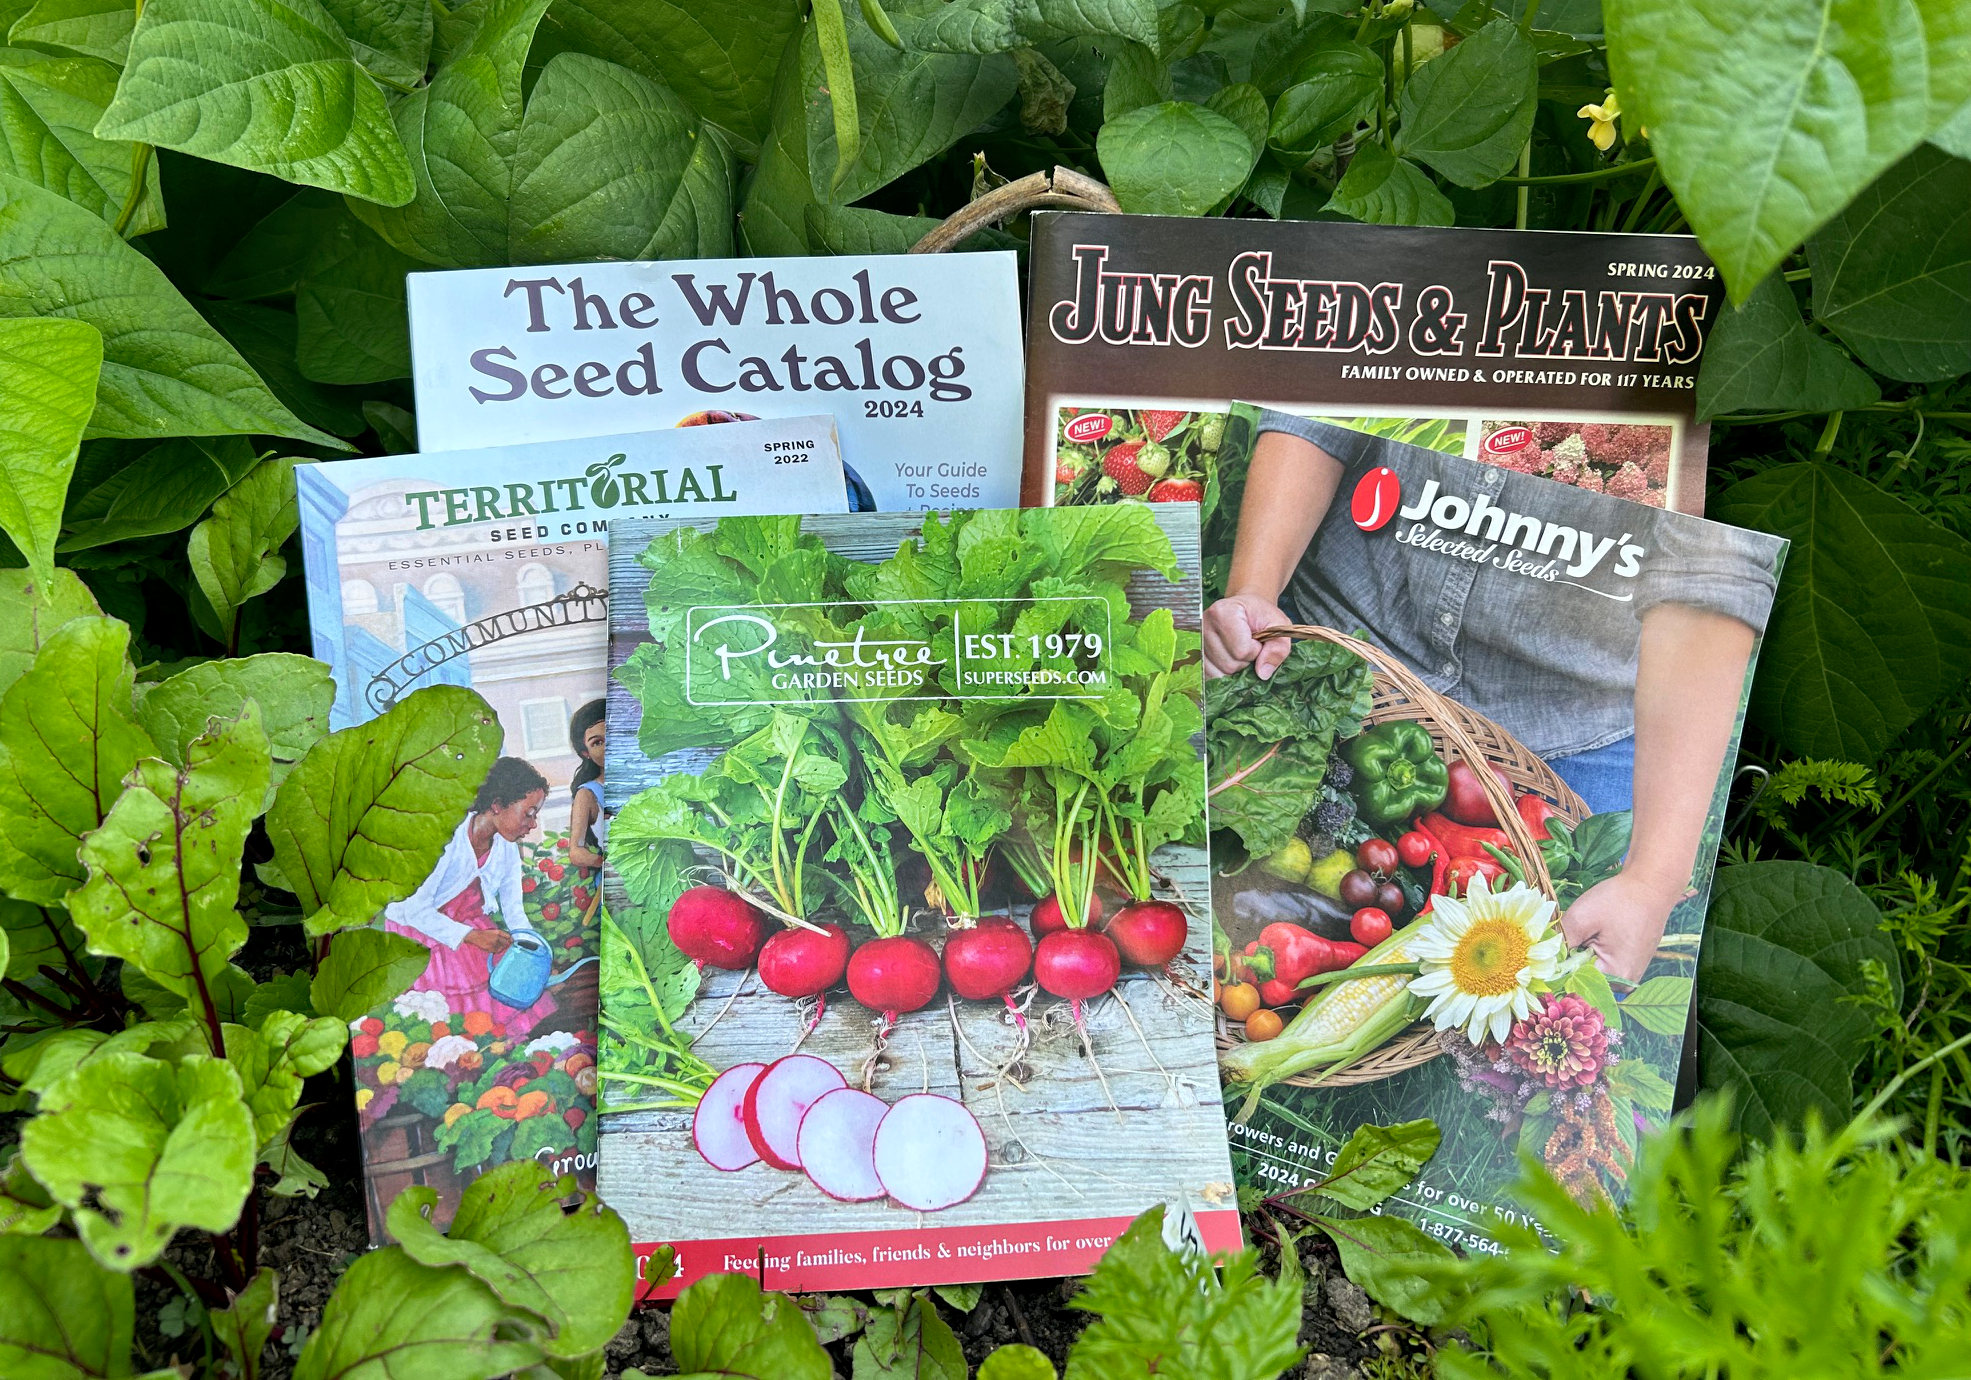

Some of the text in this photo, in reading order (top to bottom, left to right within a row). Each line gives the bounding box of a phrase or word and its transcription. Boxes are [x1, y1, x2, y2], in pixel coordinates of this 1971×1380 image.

[1607, 263, 1716, 280] SPRING 2024
[503, 268, 922, 333] The Whole
[1048, 245, 1709, 366] JUNG SEEDS & PLANTS
[468, 337, 972, 404] Seed Catalog
[1340, 365, 1694, 389] FAMILY OWNED & OPERATED FOR 117 YEARS
[864, 400, 924, 418] 2024
[1074, 419, 1105, 434] NEW!
[763, 440, 815, 453] SPRING
[1494, 431, 1525, 447] NEW!
[773, 453, 809, 465] 2022
[894, 462, 987, 477] Your Guide
[405, 454, 737, 531] TERRITORIAL
[906, 483, 980, 498] To Seeds
[490, 524, 549, 542] SEED
[1400, 479, 1645, 578] Johnny's
[388, 552, 495, 572] ESSENTIAL
[505, 546, 573, 560] SEEDS,
[1395, 523, 1560, 583] Selected Seeds
[964, 633, 1101, 659] EST. 1979
[772, 669, 924, 690] GARDEN SEEDS
[964, 669, 1107, 686] SUPERSEEDS.COM
[1226, 1117, 1283, 1148] rowers
[1288, 1140, 1321, 1161] and
[1417, 1180, 1444, 1200] for
[1448, 1194, 1487, 1214] over
[1258, 1162, 1299, 1187] 2024
[796, 1248, 867, 1267] families,
[872, 1244, 931, 1263] friends
[937, 1242, 952, 1259] &
[957, 1235, 1041, 1260] neighbors
[1046, 1235, 1071, 1251] for
[1076, 1235, 1112, 1250] over
[1420, 1217, 1510, 1261] 1-877-564-
